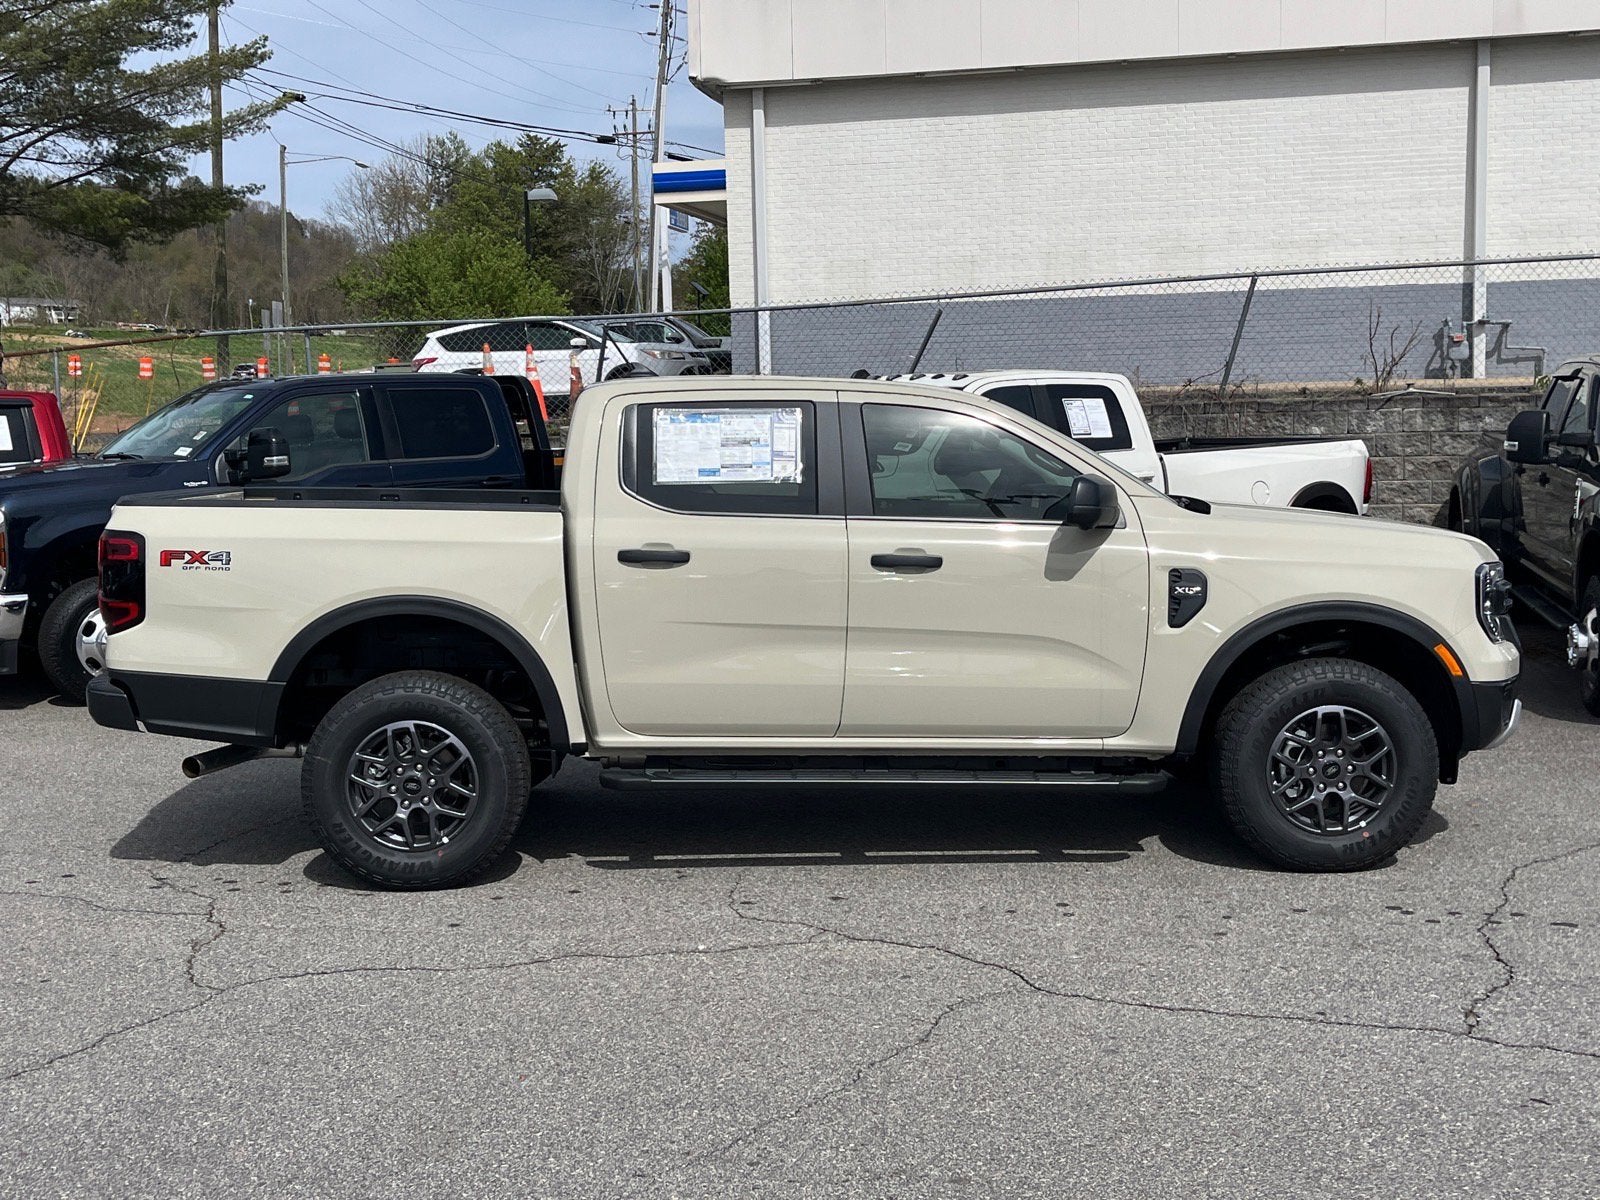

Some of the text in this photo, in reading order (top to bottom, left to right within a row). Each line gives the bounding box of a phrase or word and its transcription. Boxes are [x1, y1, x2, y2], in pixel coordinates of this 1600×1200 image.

[159, 550, 231, 567] FX4
[1343, 775, 1419, 853] GOODYEAR
[333, 820, 437, 875] WRANGLER
